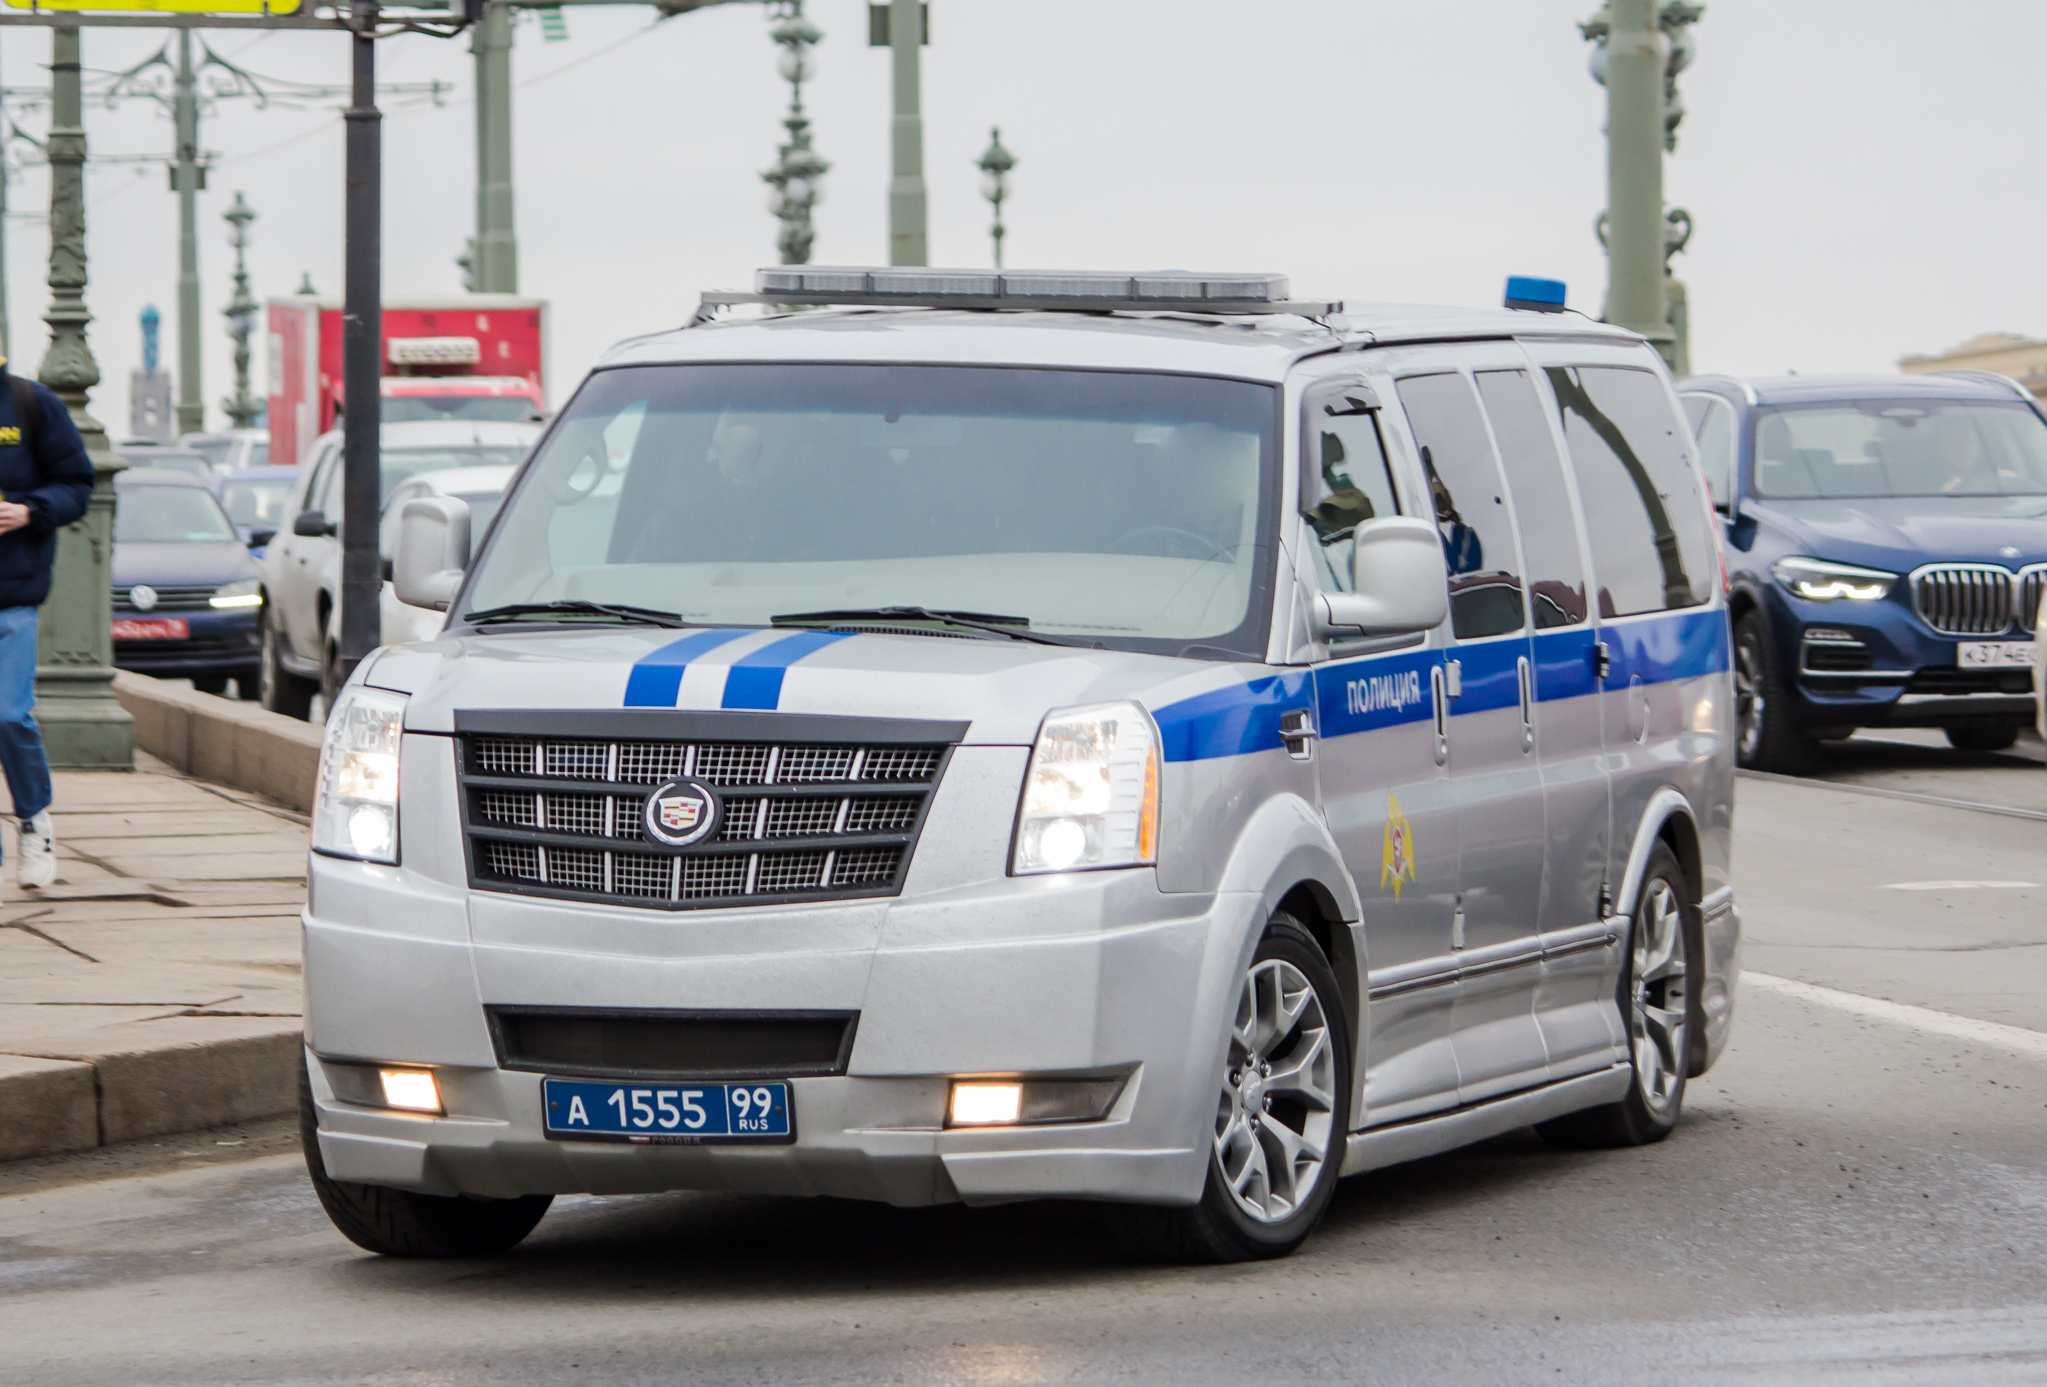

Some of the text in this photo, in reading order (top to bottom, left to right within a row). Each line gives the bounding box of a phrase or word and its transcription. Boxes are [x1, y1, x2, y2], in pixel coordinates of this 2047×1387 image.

[1347, 670, 1420, 715] ПОЛИЦИЯ
[568, 1087, 772, 1129] А 1555 99
[739, 1118, 769, 1130] RUS
